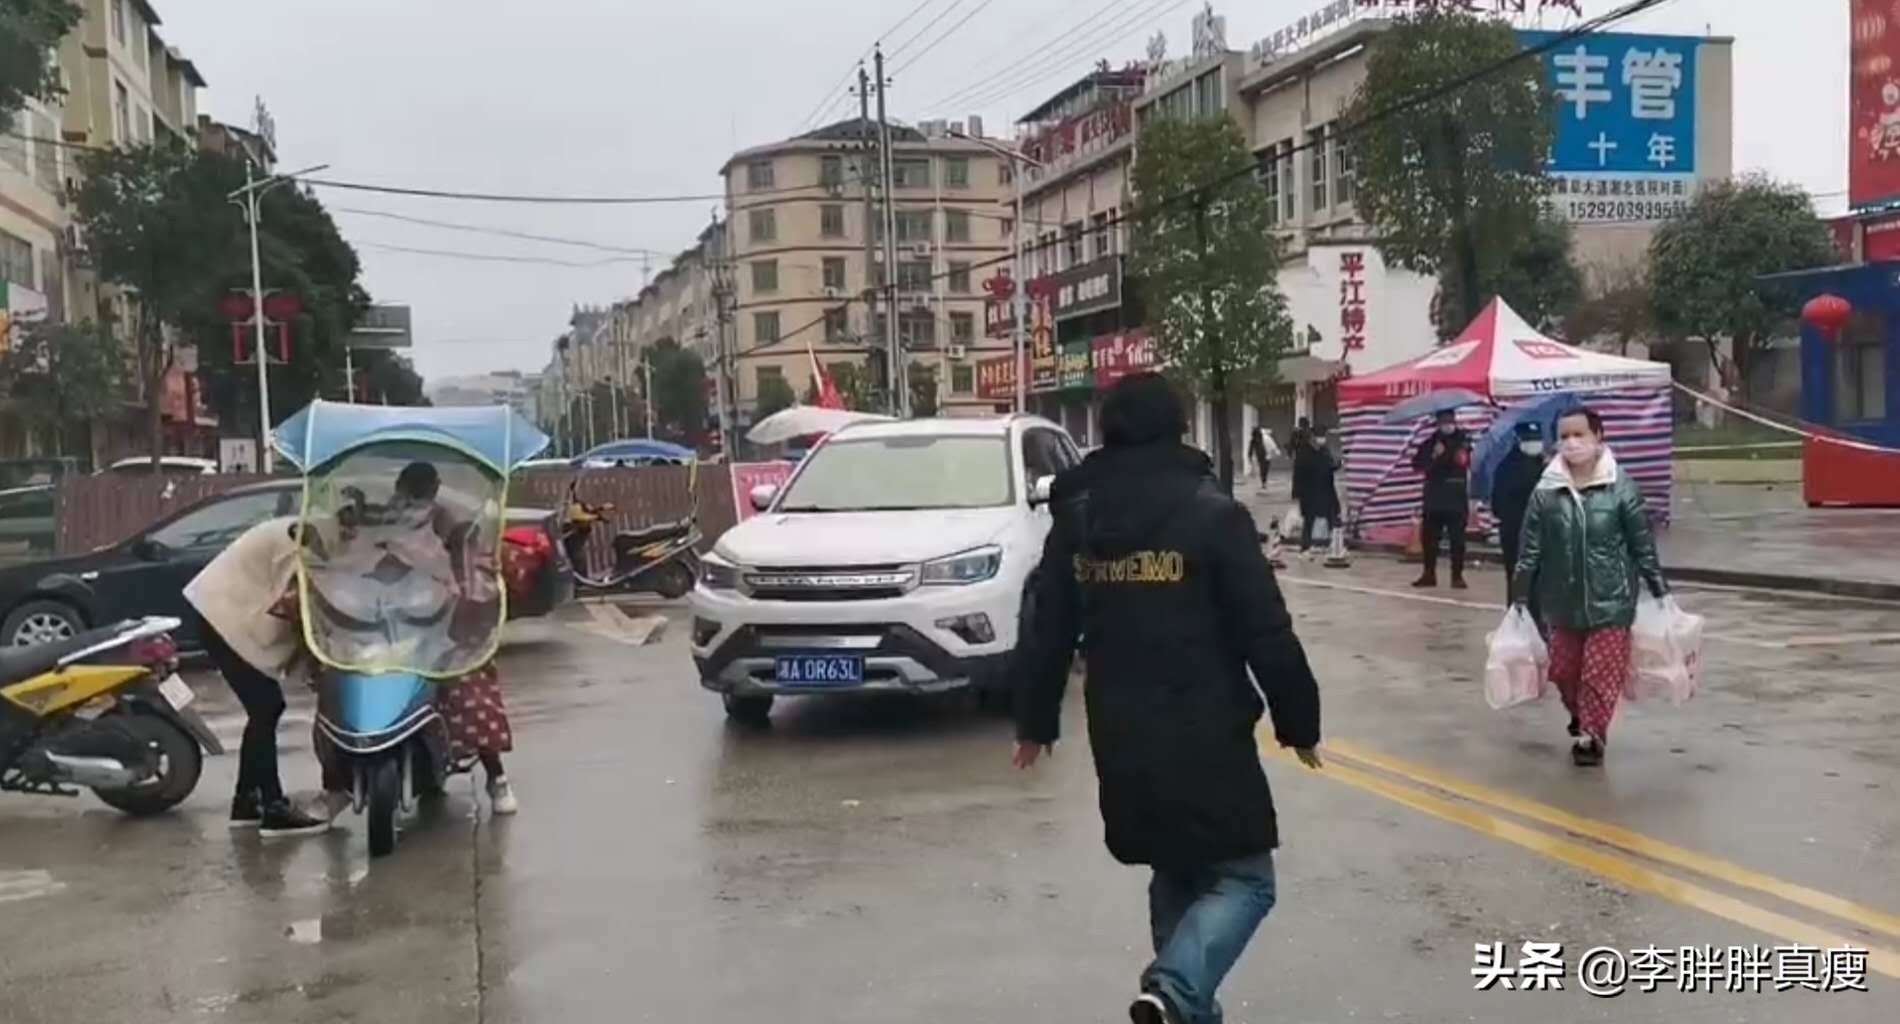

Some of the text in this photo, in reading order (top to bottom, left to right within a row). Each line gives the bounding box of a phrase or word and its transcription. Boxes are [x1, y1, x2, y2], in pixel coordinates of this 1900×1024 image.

[1340, 252, 1366, 361] 平江特产
[1531, 376, 1563, 391] TCL
